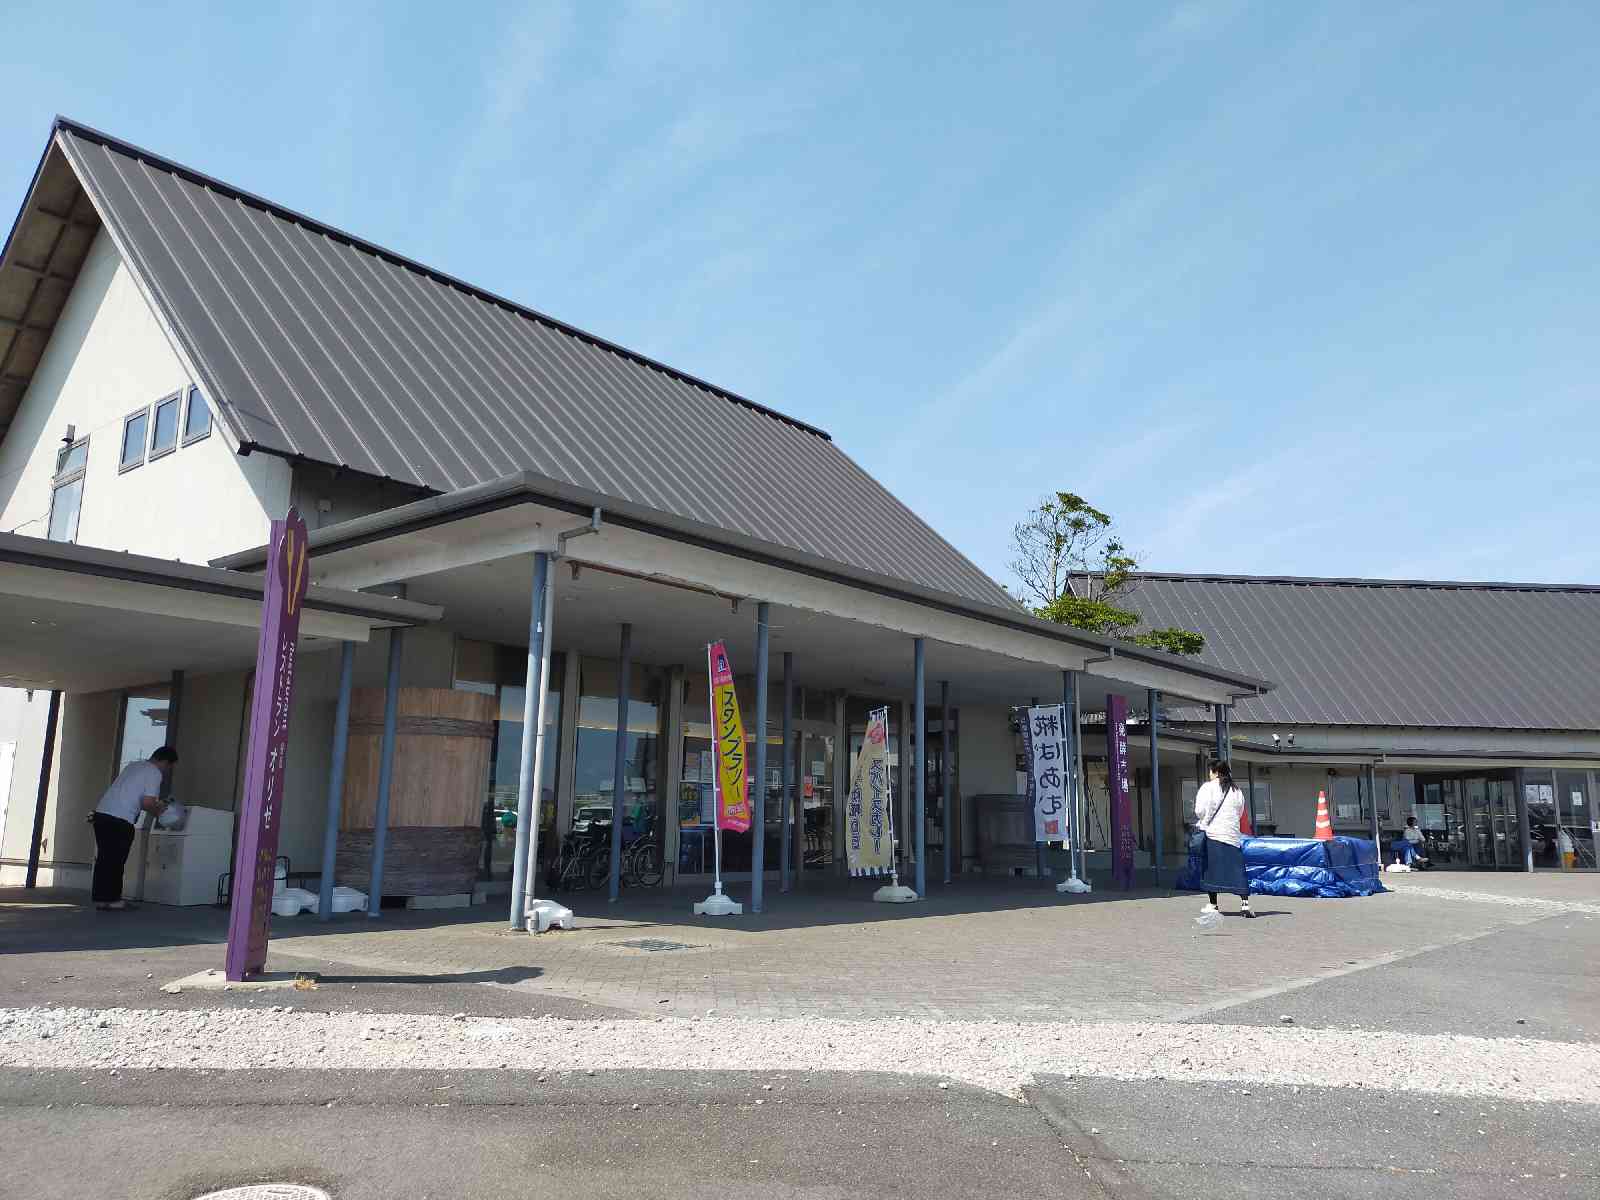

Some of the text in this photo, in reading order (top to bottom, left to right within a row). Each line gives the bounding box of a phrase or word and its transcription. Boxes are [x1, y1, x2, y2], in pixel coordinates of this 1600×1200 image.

[273, 632, 288, 737] レストラン
[263, 747, 279, 829] オリゼ
[720, 691, 743, 799] スタンプラリー
